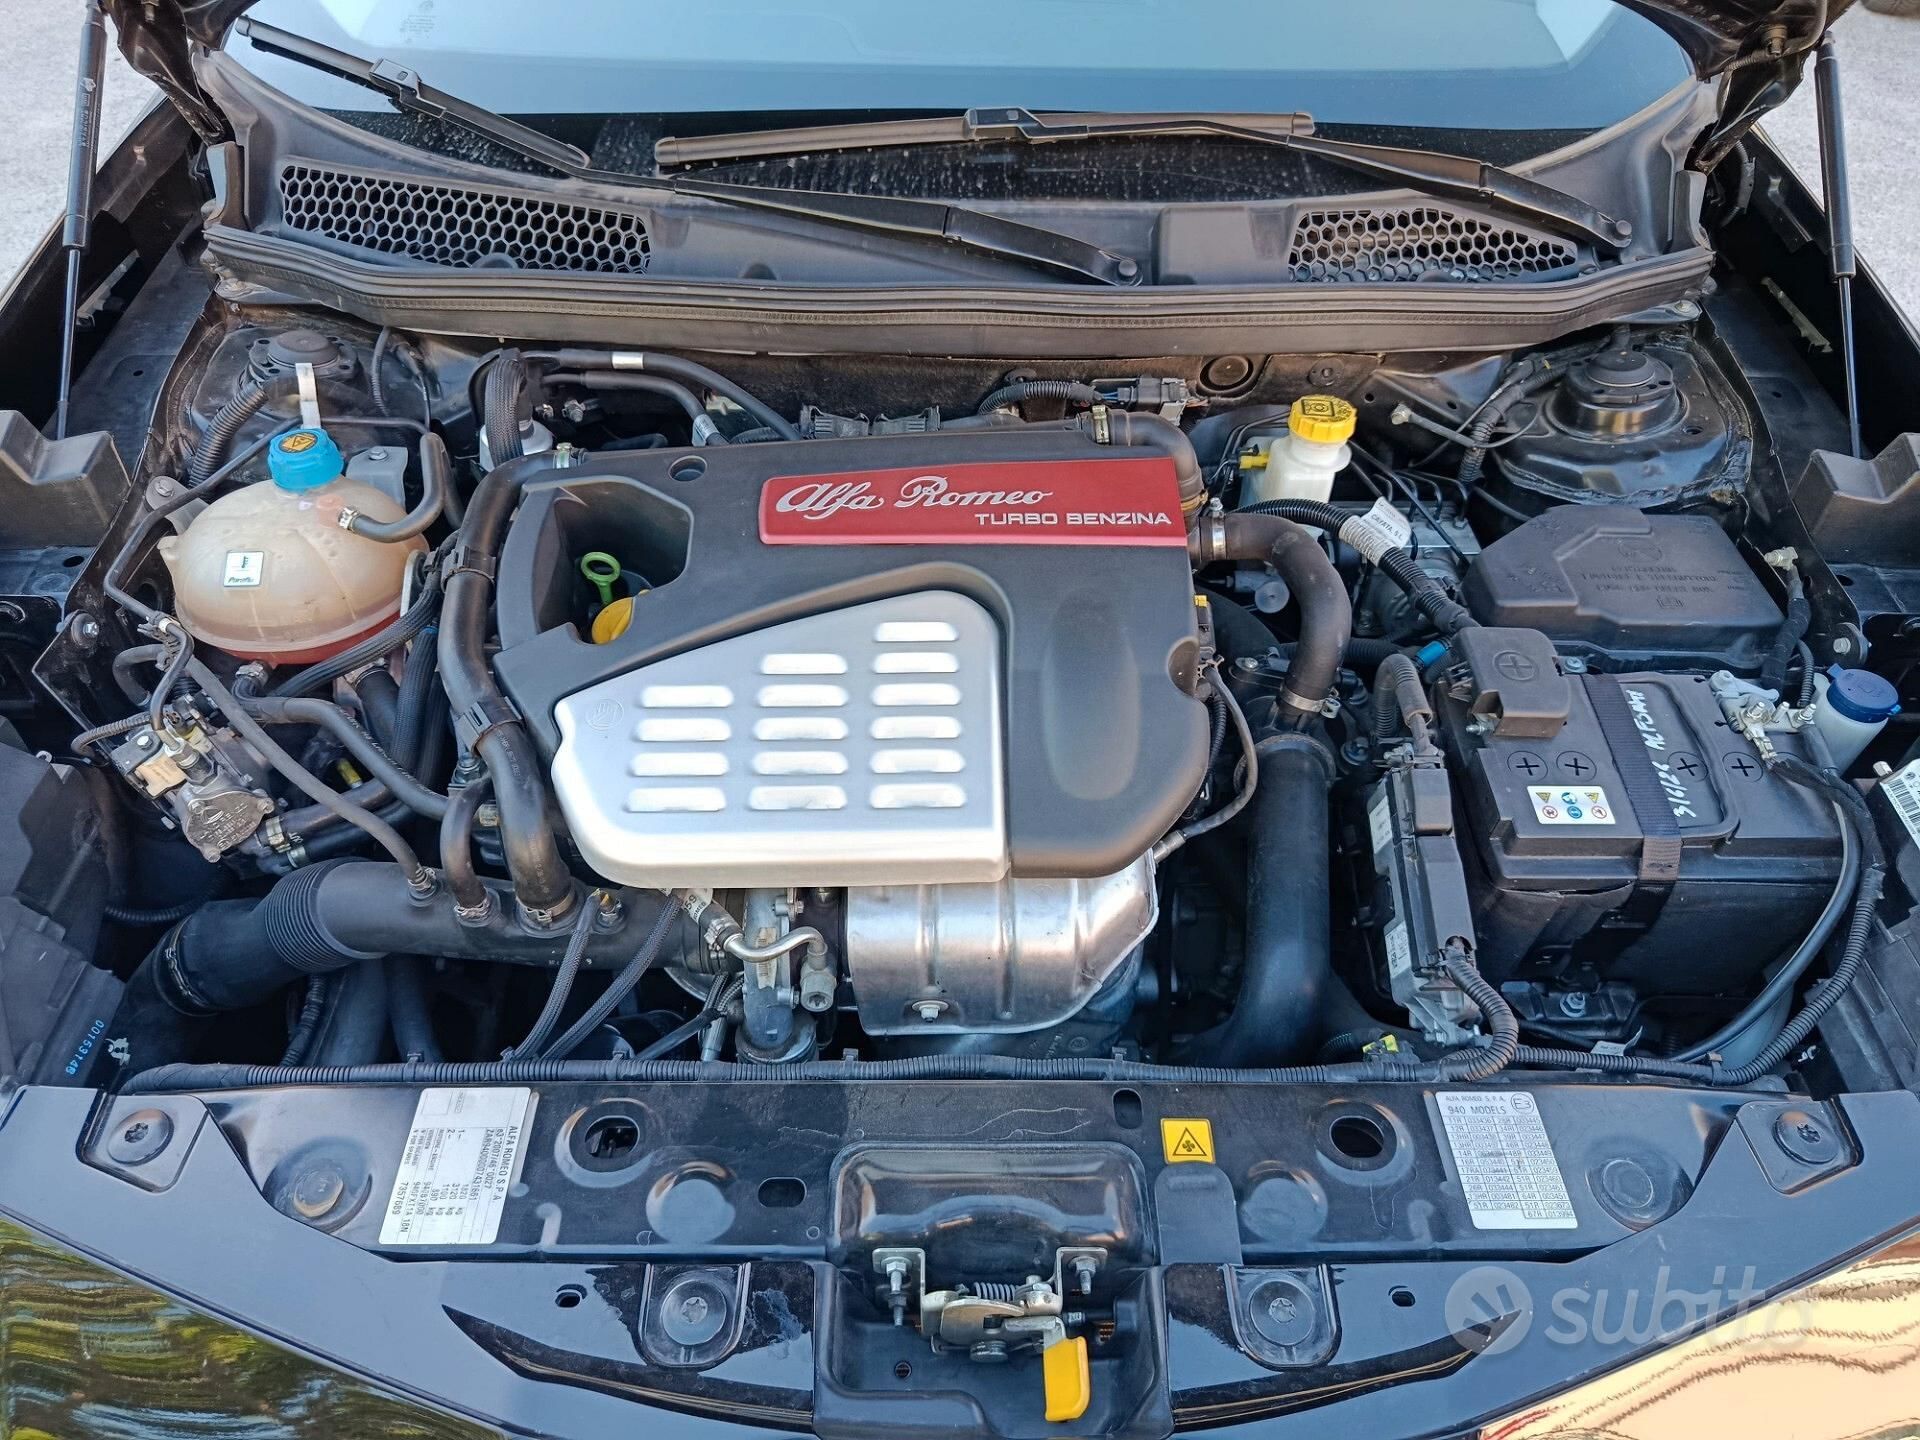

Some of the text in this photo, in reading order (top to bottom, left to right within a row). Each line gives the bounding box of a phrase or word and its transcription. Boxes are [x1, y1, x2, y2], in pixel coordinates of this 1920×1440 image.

[775, 475, 1053, 520] Alfa Romeo
[975, 512, 1171, 525] TURBO BENZINA
[1448, 1106, 1507, 1114] 940 MODELS
[505, 1126, 518, 1145] ALFA
[498, 1147, 513, 1175] ROMEO
